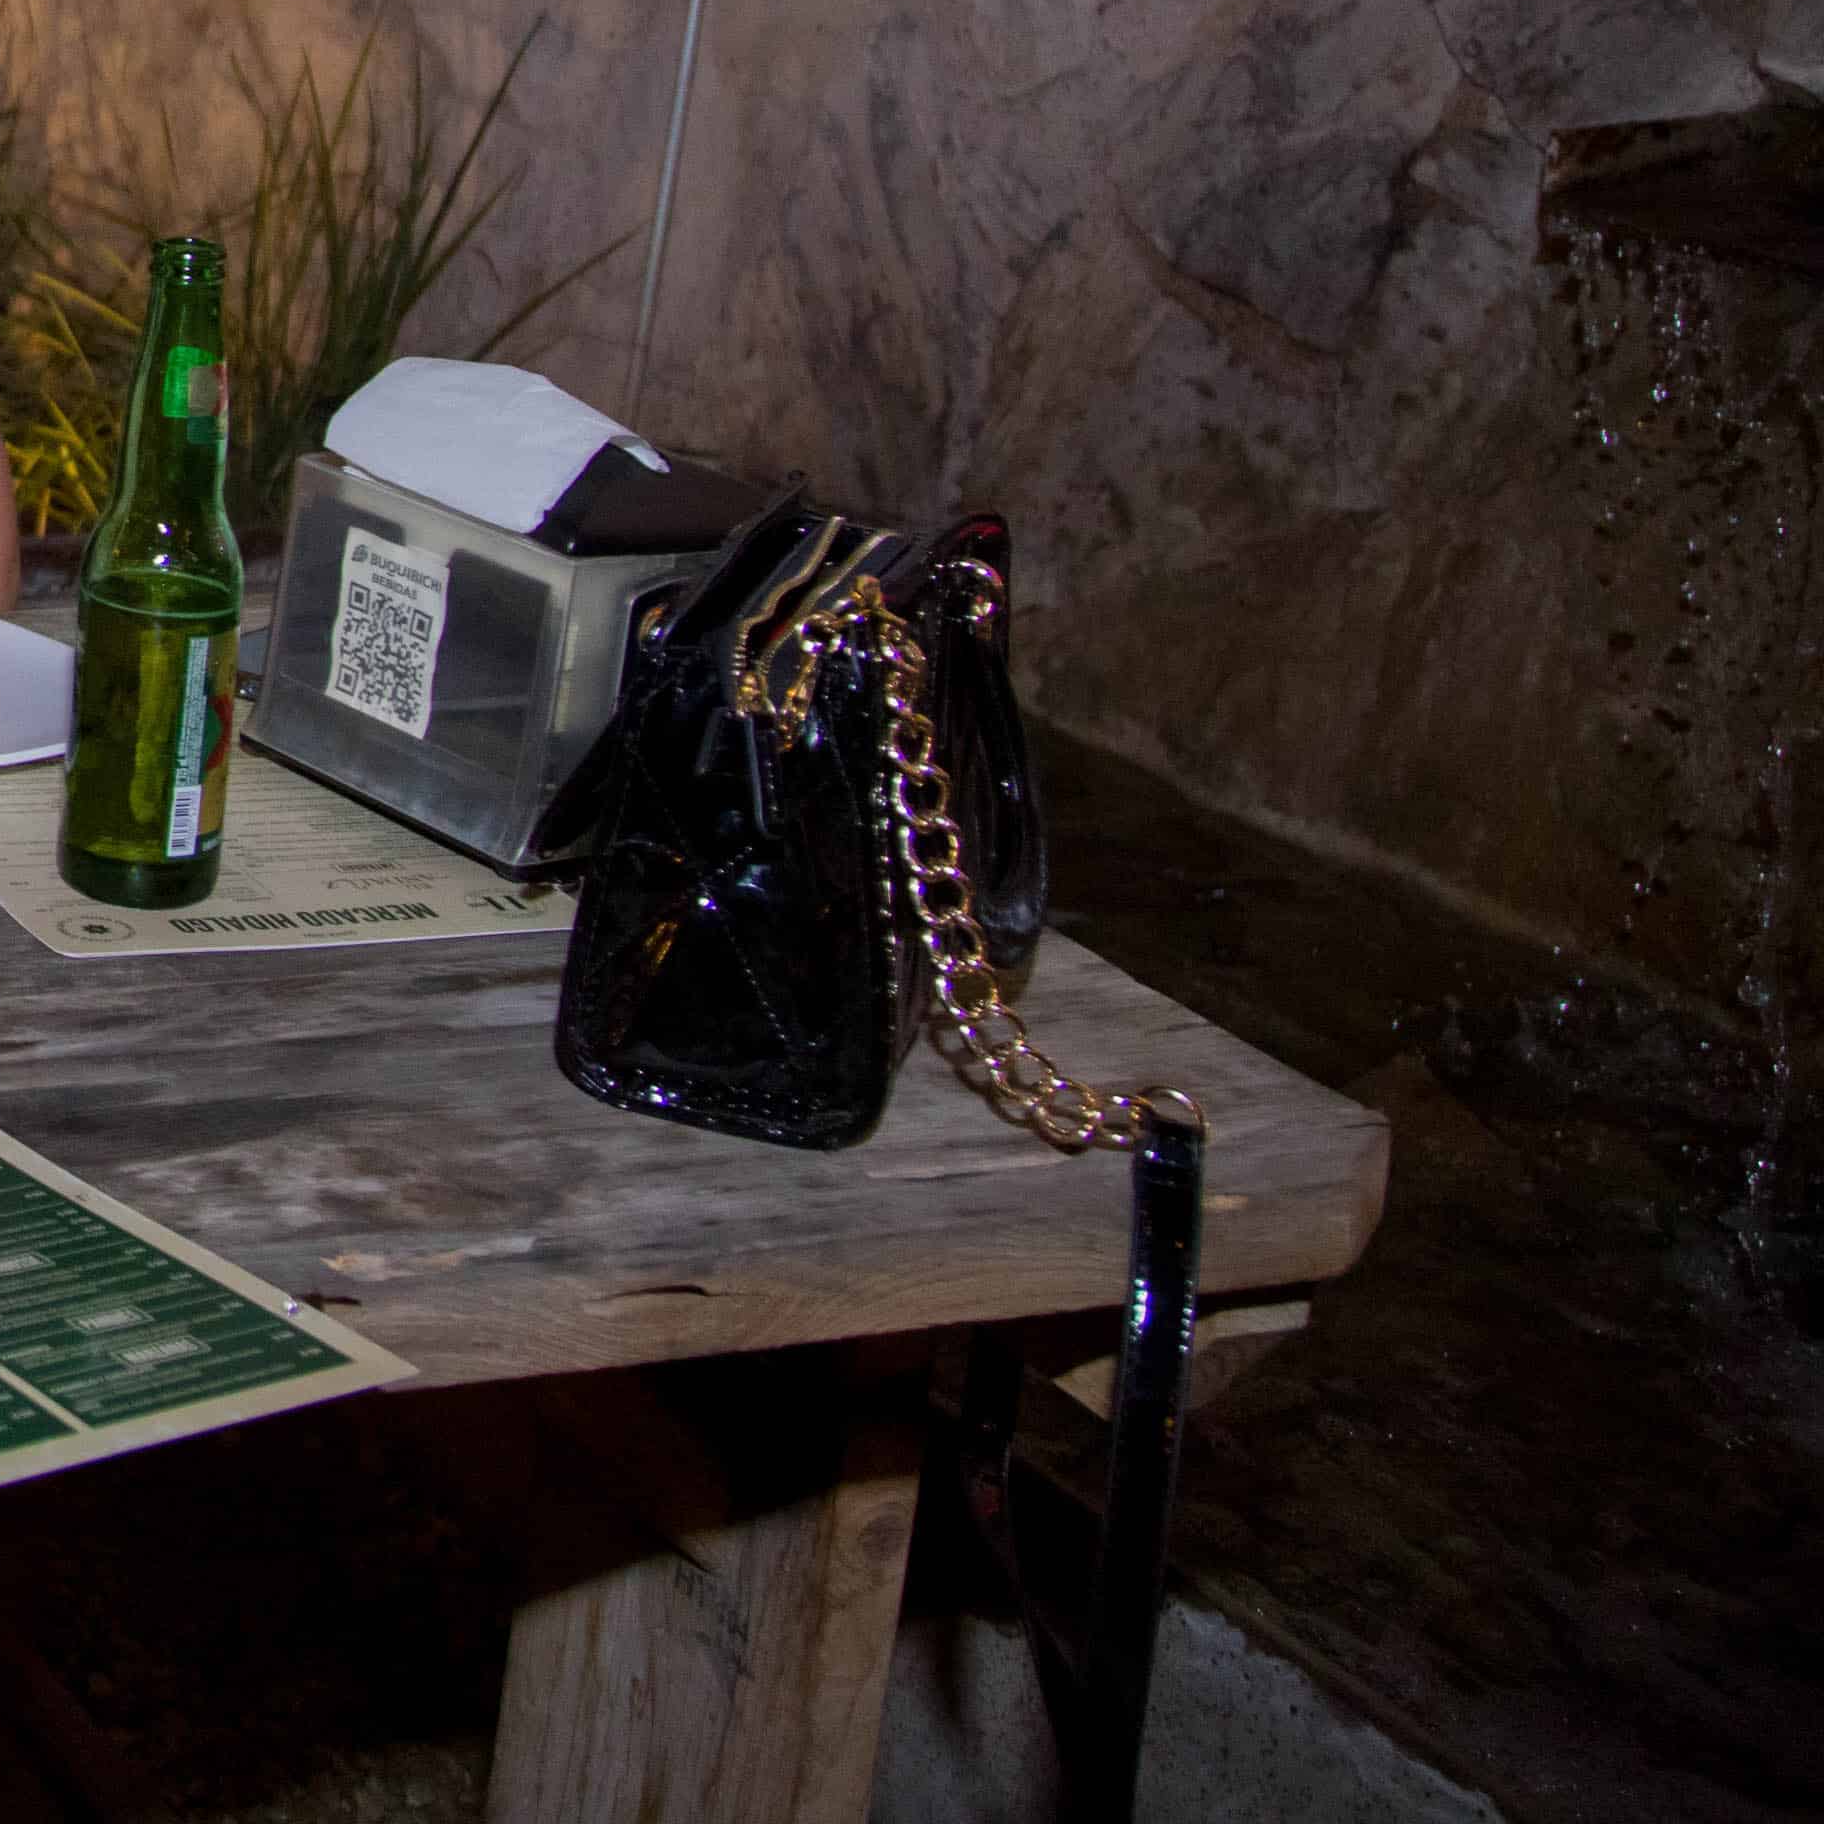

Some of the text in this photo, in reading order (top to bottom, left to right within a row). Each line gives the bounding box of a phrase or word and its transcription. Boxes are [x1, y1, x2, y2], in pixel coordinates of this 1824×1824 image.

[371, 553, 442, 593] BUQUIBICHI
[372, 573, 417, 600] BEBIDAS
[168, 902, 440, 934] MERCADO HIDALGO
